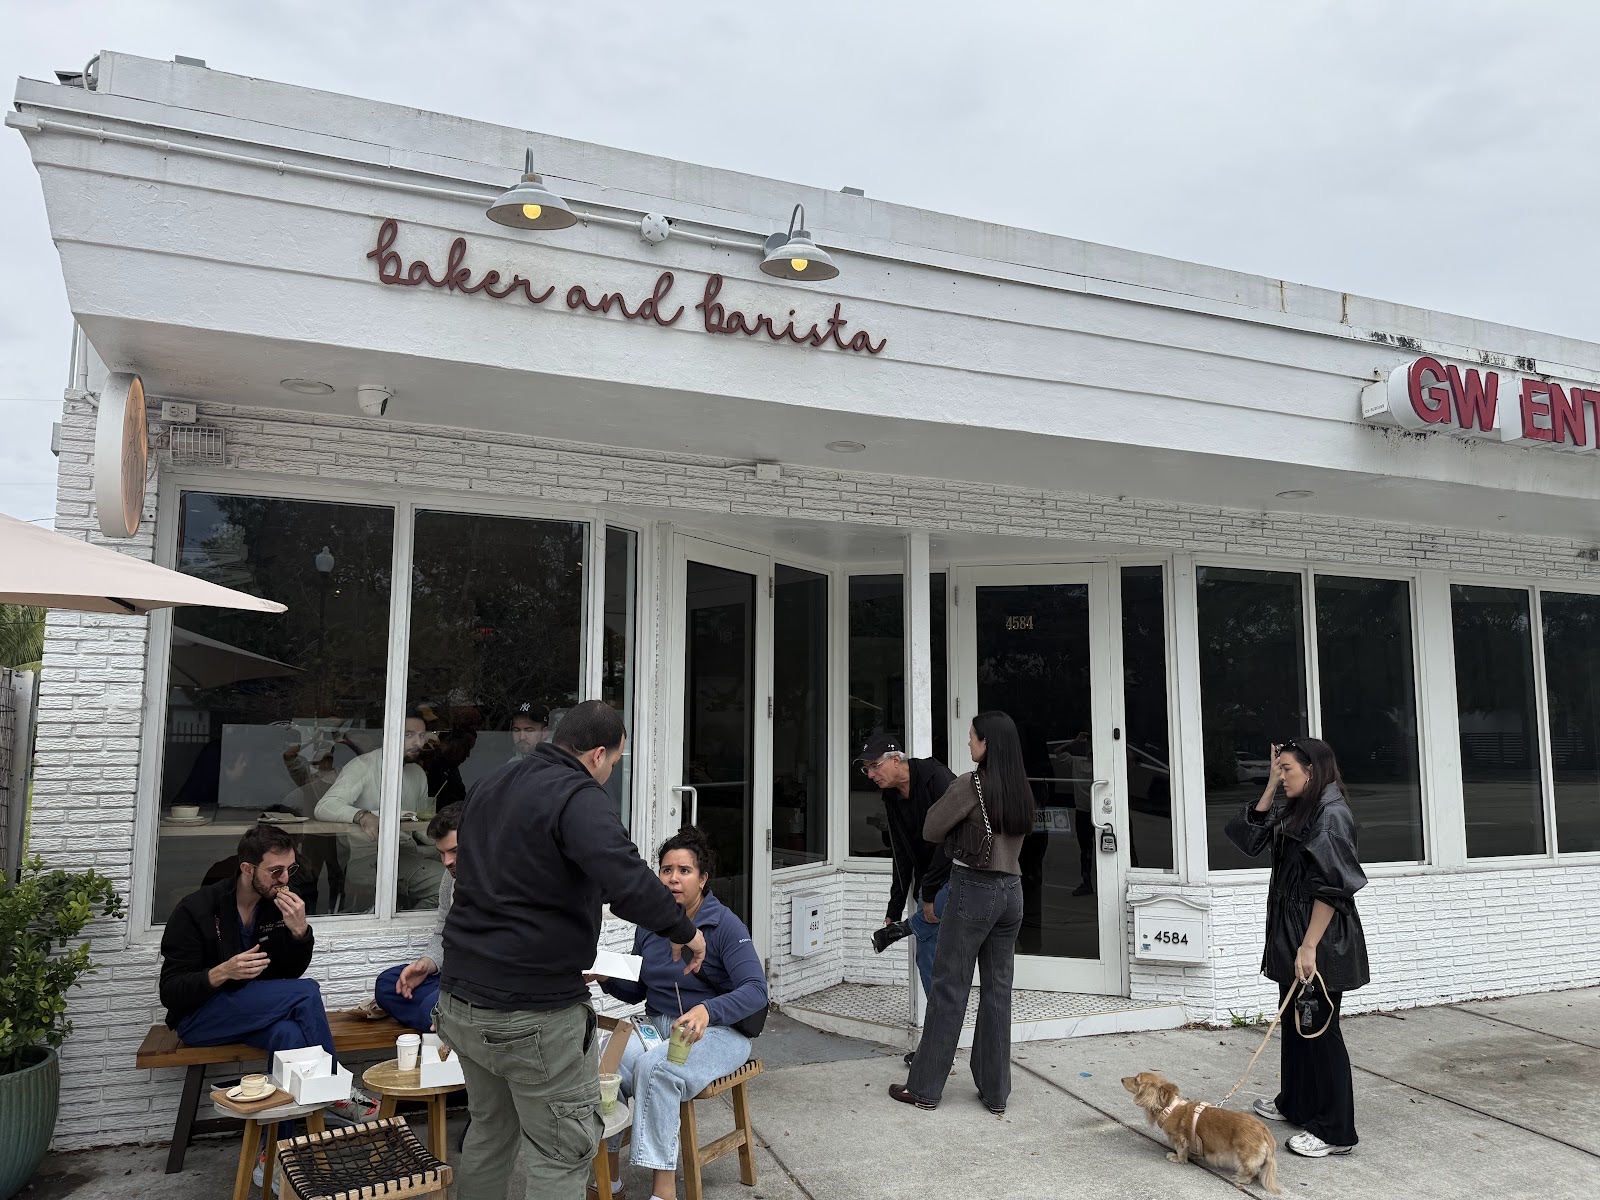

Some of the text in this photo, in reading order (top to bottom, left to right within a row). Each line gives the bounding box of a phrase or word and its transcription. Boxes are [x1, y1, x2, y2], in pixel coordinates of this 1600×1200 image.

[367, 218, 887, 354] baker and barista
[1408, 356, 1498, 432] GW
[1006, 616, 1033, 630] 4584
[1154, 930, 1188, 945] 4584
